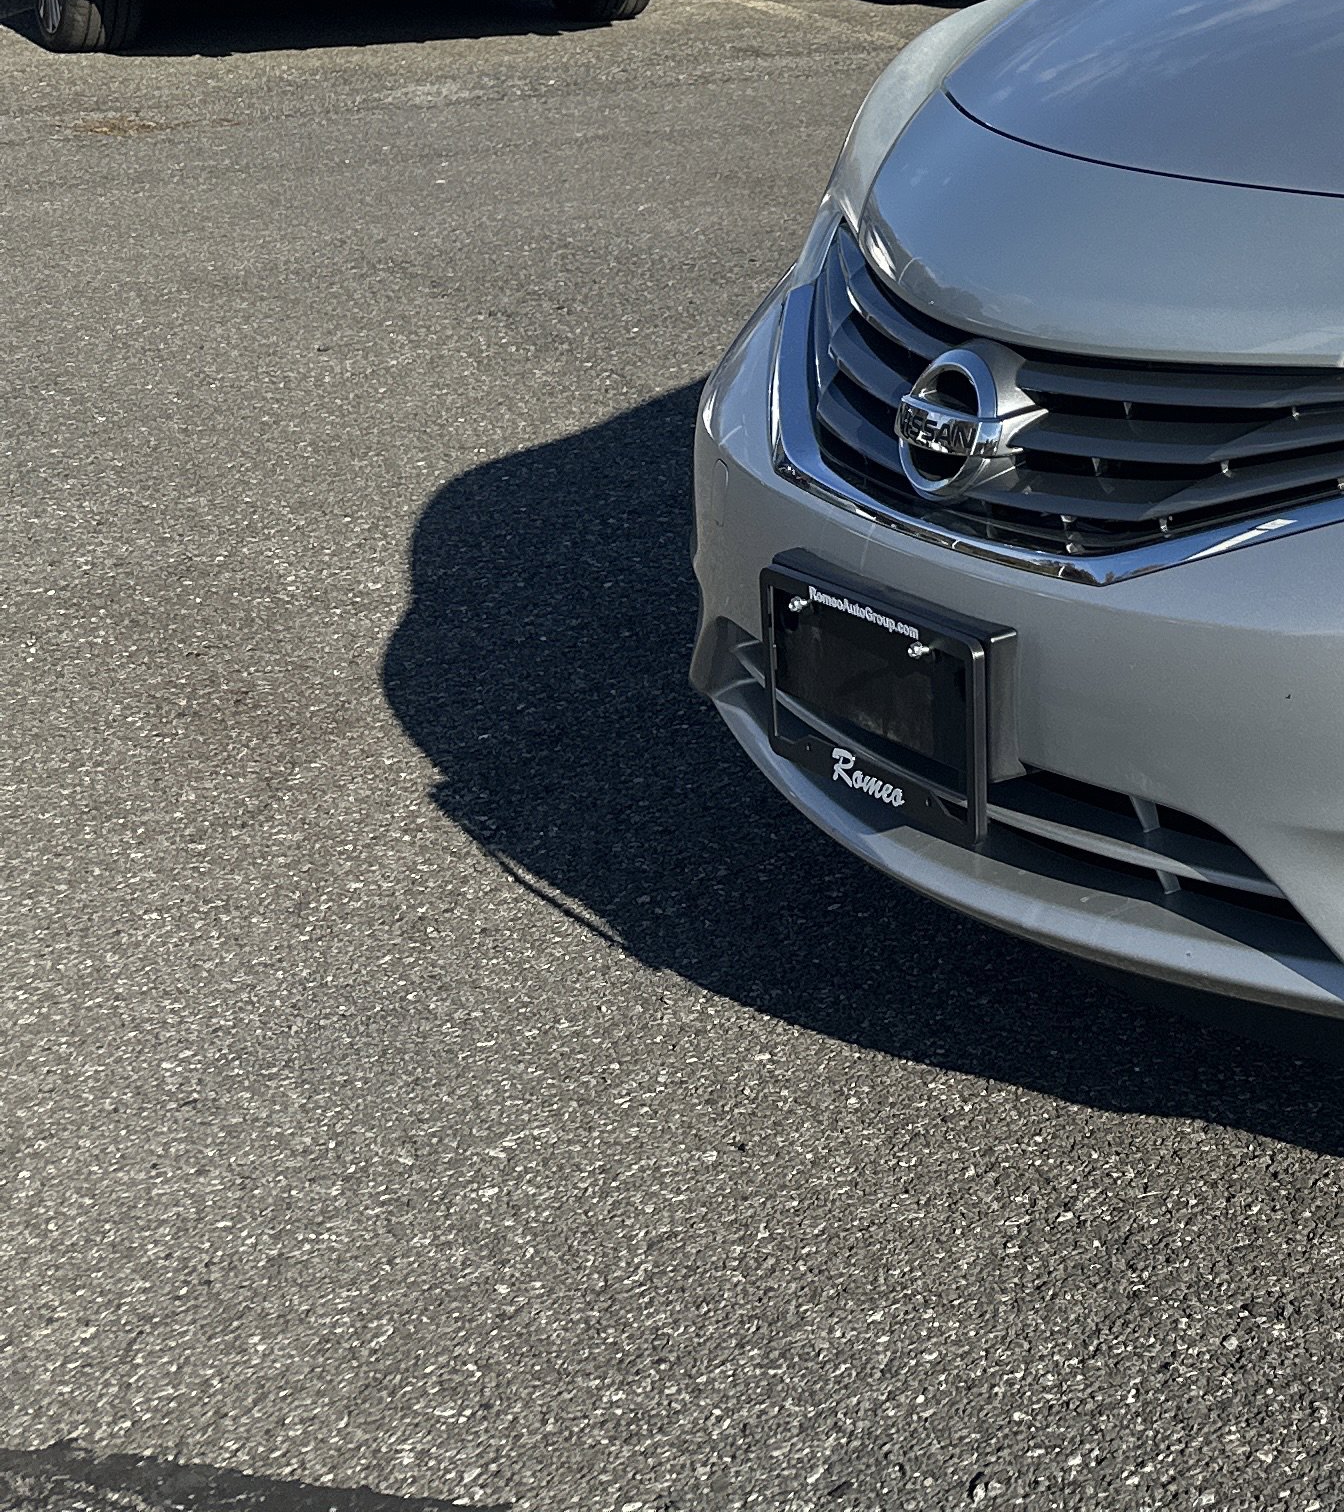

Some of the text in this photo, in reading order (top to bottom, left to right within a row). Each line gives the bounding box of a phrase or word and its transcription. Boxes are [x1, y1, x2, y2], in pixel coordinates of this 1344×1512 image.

[901, 402, 977, 450] NISSAN
[809, 586, 919, 640] RomeoAutoGroup.com
[832, 748, 905, 806] Romeo
